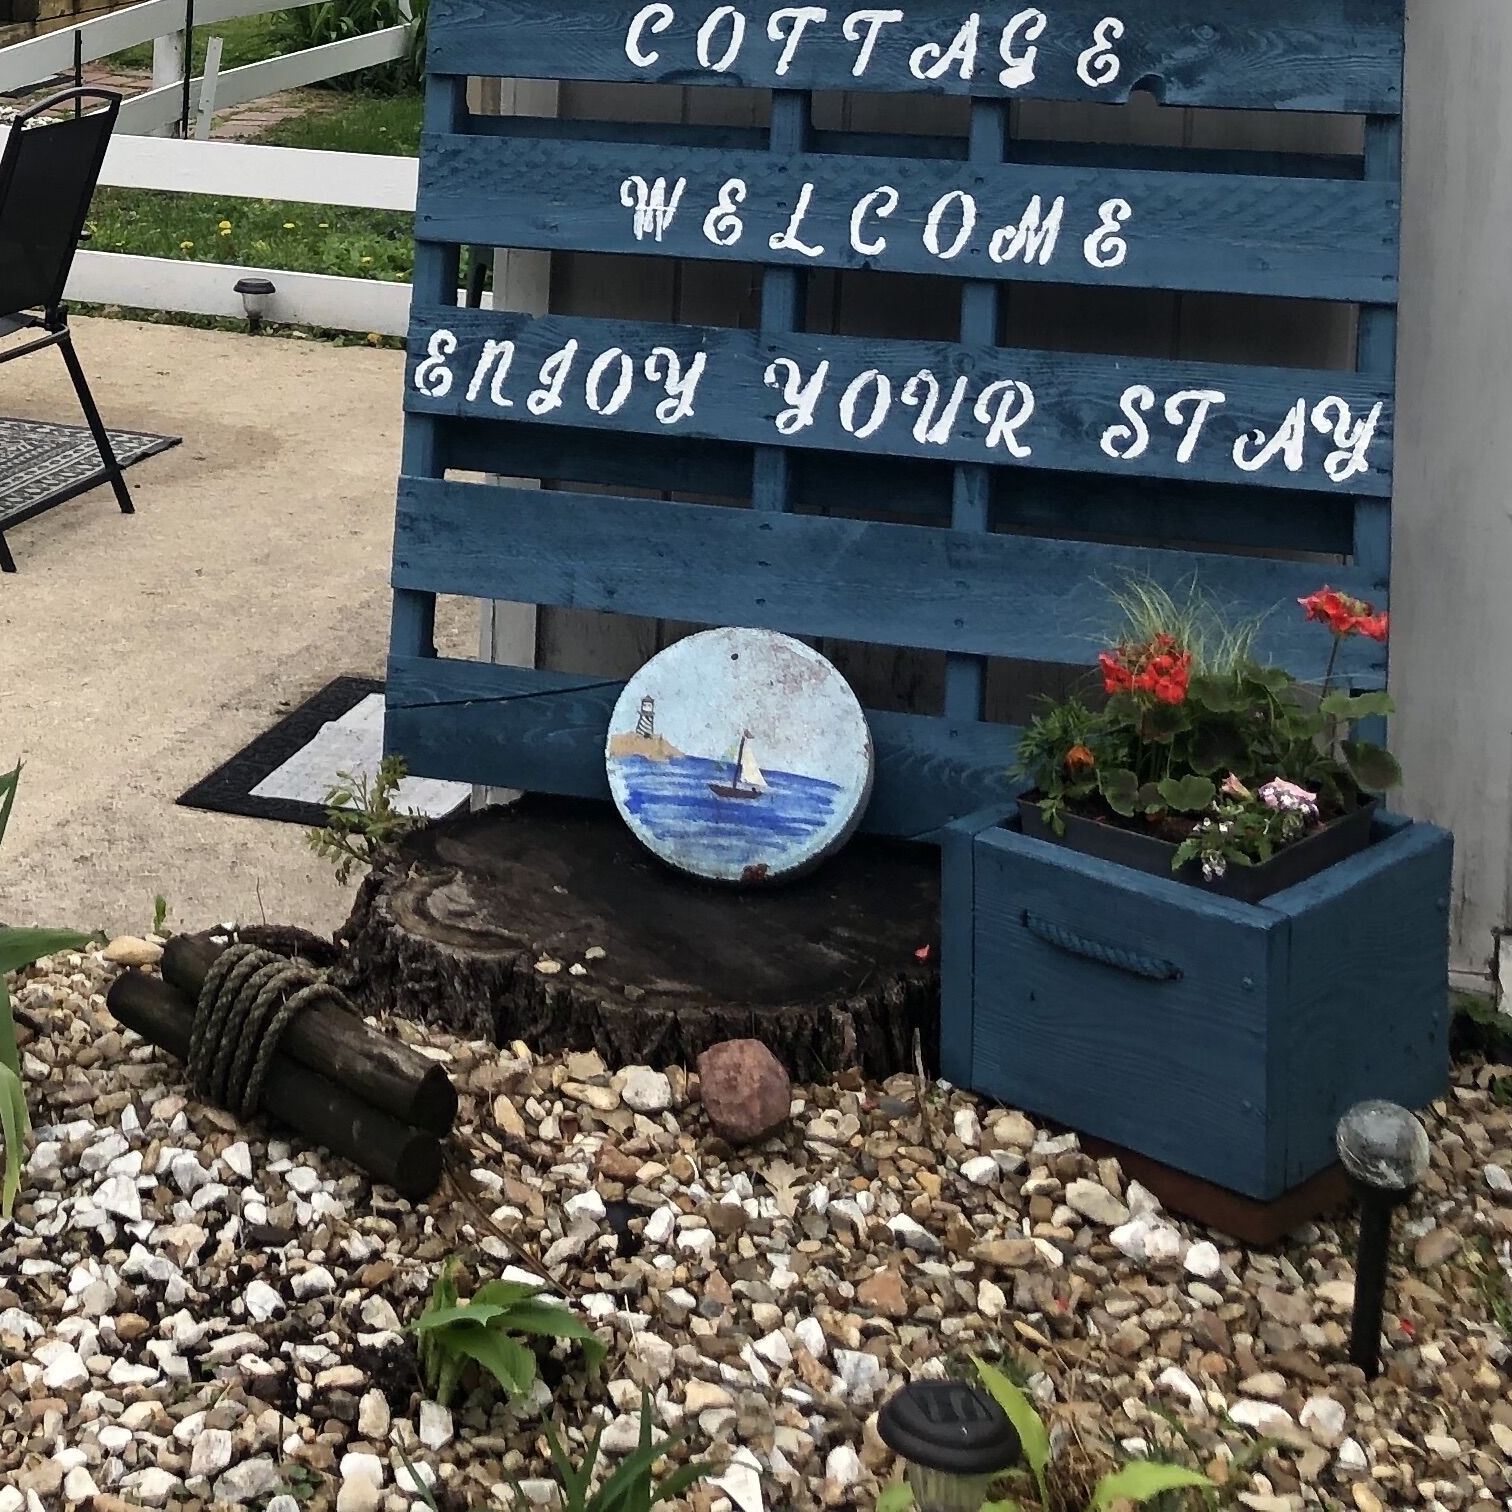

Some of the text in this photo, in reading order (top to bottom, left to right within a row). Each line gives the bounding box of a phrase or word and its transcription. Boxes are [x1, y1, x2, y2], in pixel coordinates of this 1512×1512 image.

[624, 2, 1125, 89] COTTAGE
[619, 175, 1132, 268] WELCOME
[414, 328, 1384, 483] ENJOY YOUR STAY
